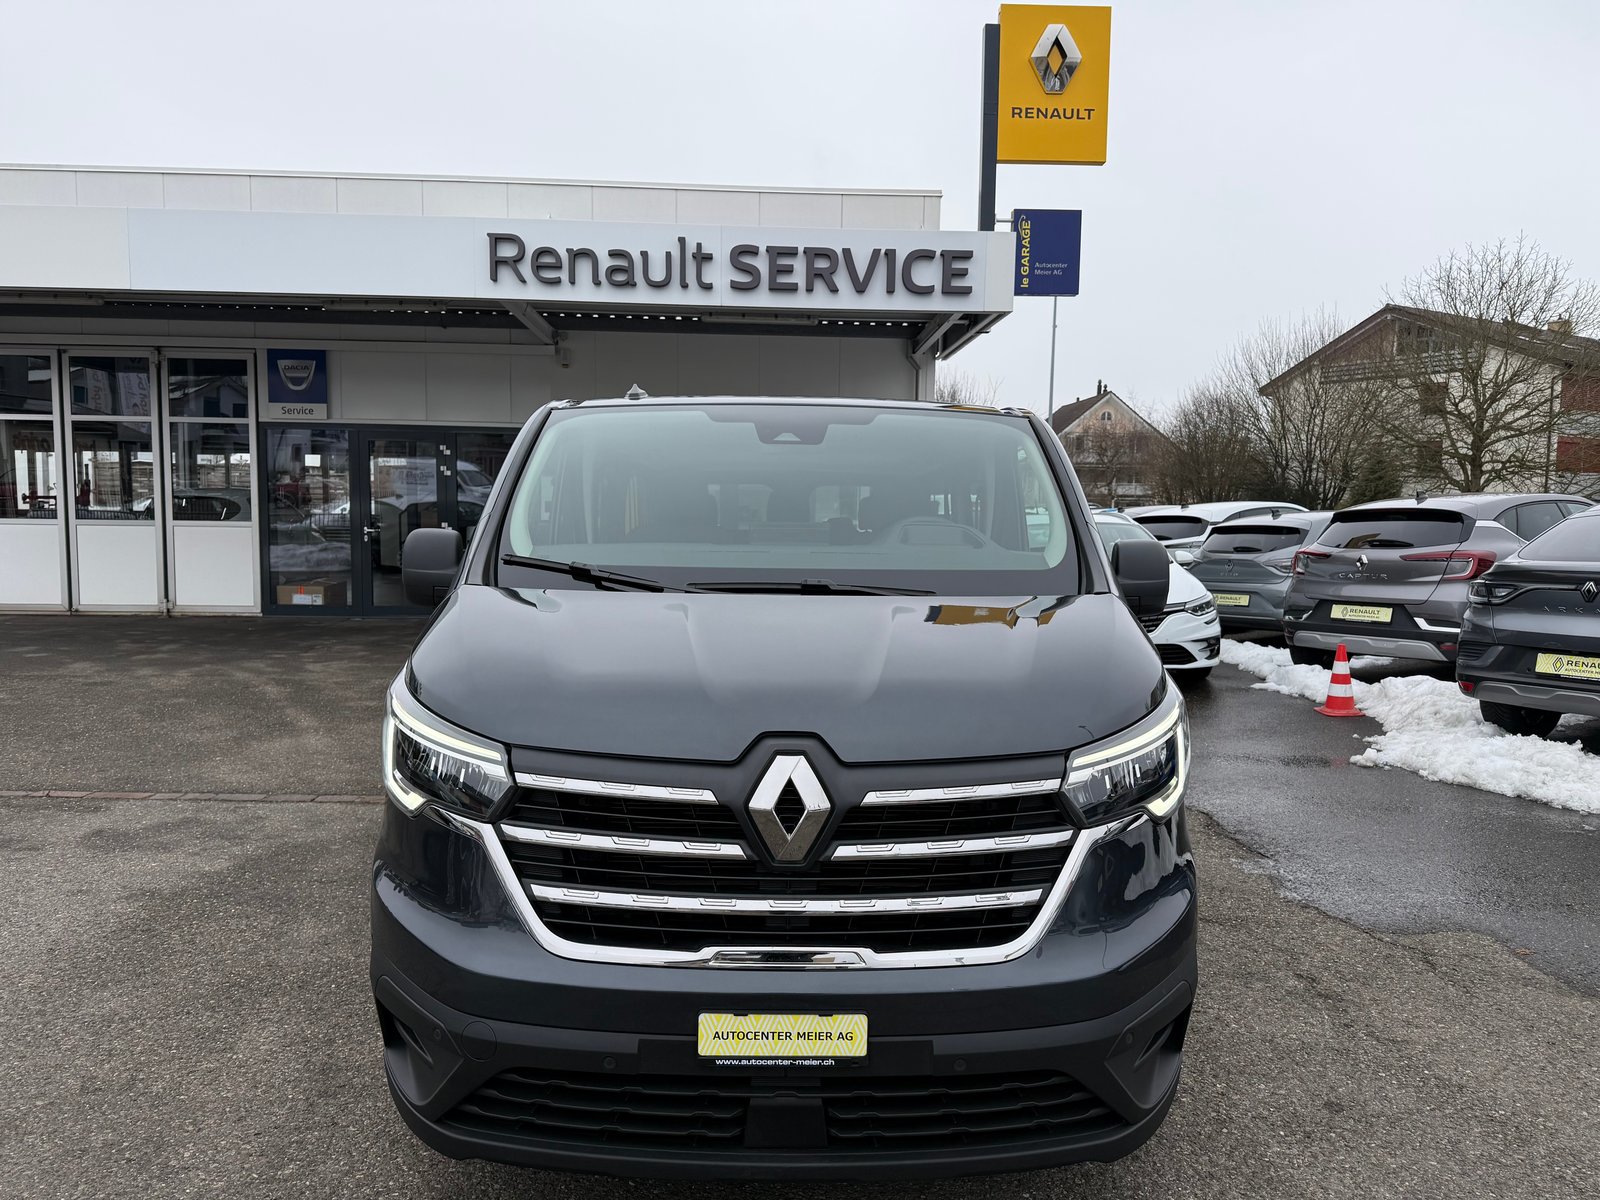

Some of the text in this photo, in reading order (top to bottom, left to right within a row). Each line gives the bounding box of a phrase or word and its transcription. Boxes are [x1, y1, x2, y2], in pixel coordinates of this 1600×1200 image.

[1010, 106, 1095, 121] RENAULT
[1020, 220, 1031, 288] le GARAGE
[486, 232, 974, 296] Renault SERVICE
[281, 405, 314, 416] Service
[1338, 572, 1388, 580] CAPTUR
[1349, 608, 1380, 616] RENAULT
[712, 1030, 854, 1042] AUTOCENTER MEIER AG
[715, 1058, 835, 1066] www.autocenter-meier.ch
